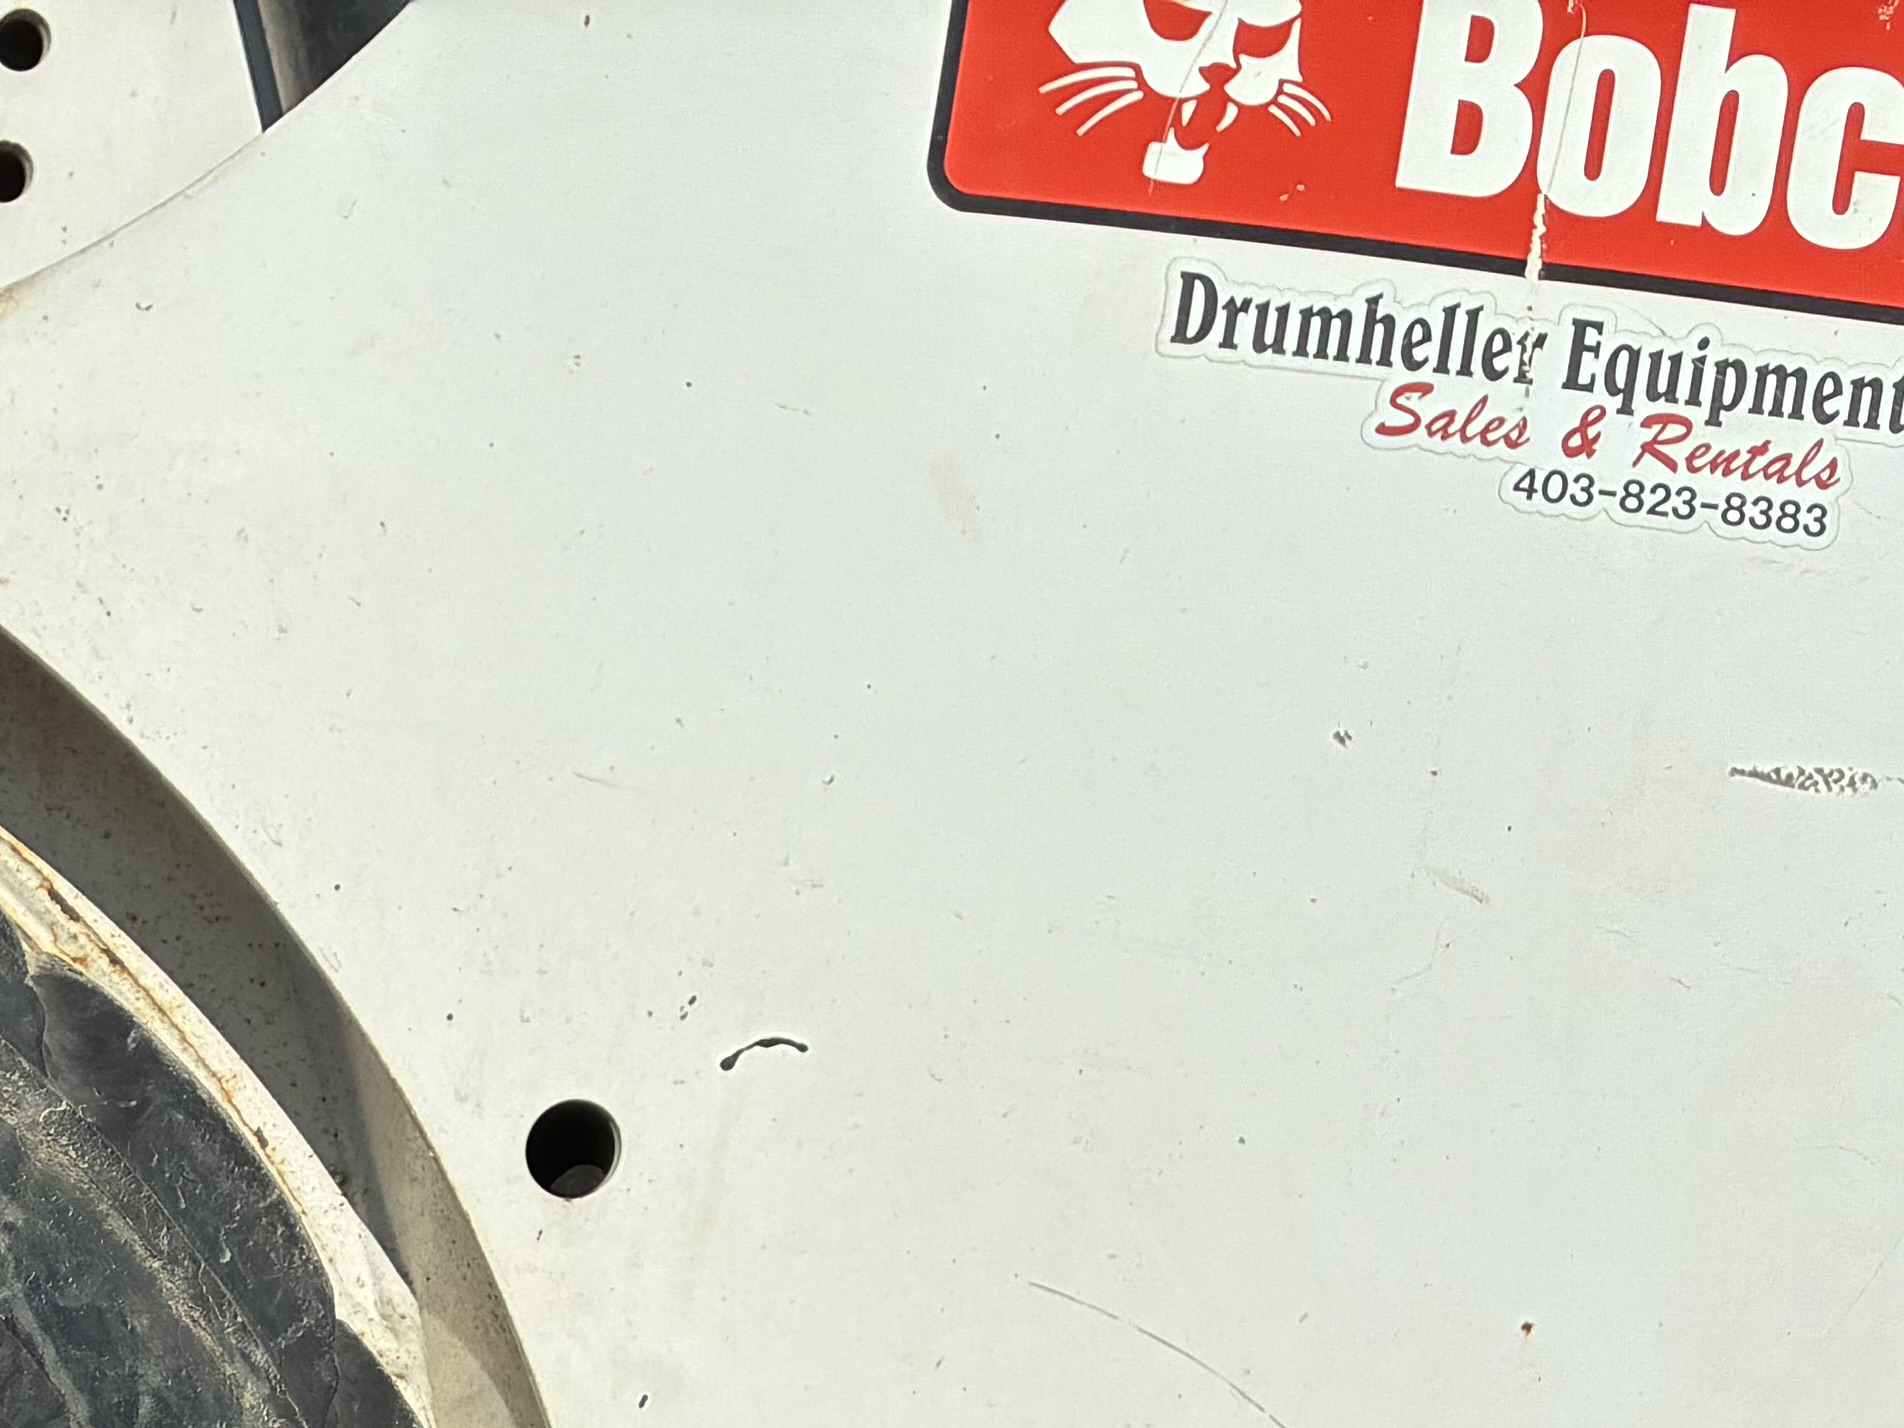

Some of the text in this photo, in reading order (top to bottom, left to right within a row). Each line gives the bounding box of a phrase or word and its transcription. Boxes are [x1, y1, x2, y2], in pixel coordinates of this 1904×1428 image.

[1170, 268, 1904, 434] Drumheller Equipment
[1374, 381, 1841, 491] Sales & Rentals
[1511, 466, 1828, 540] 403-823-8383
